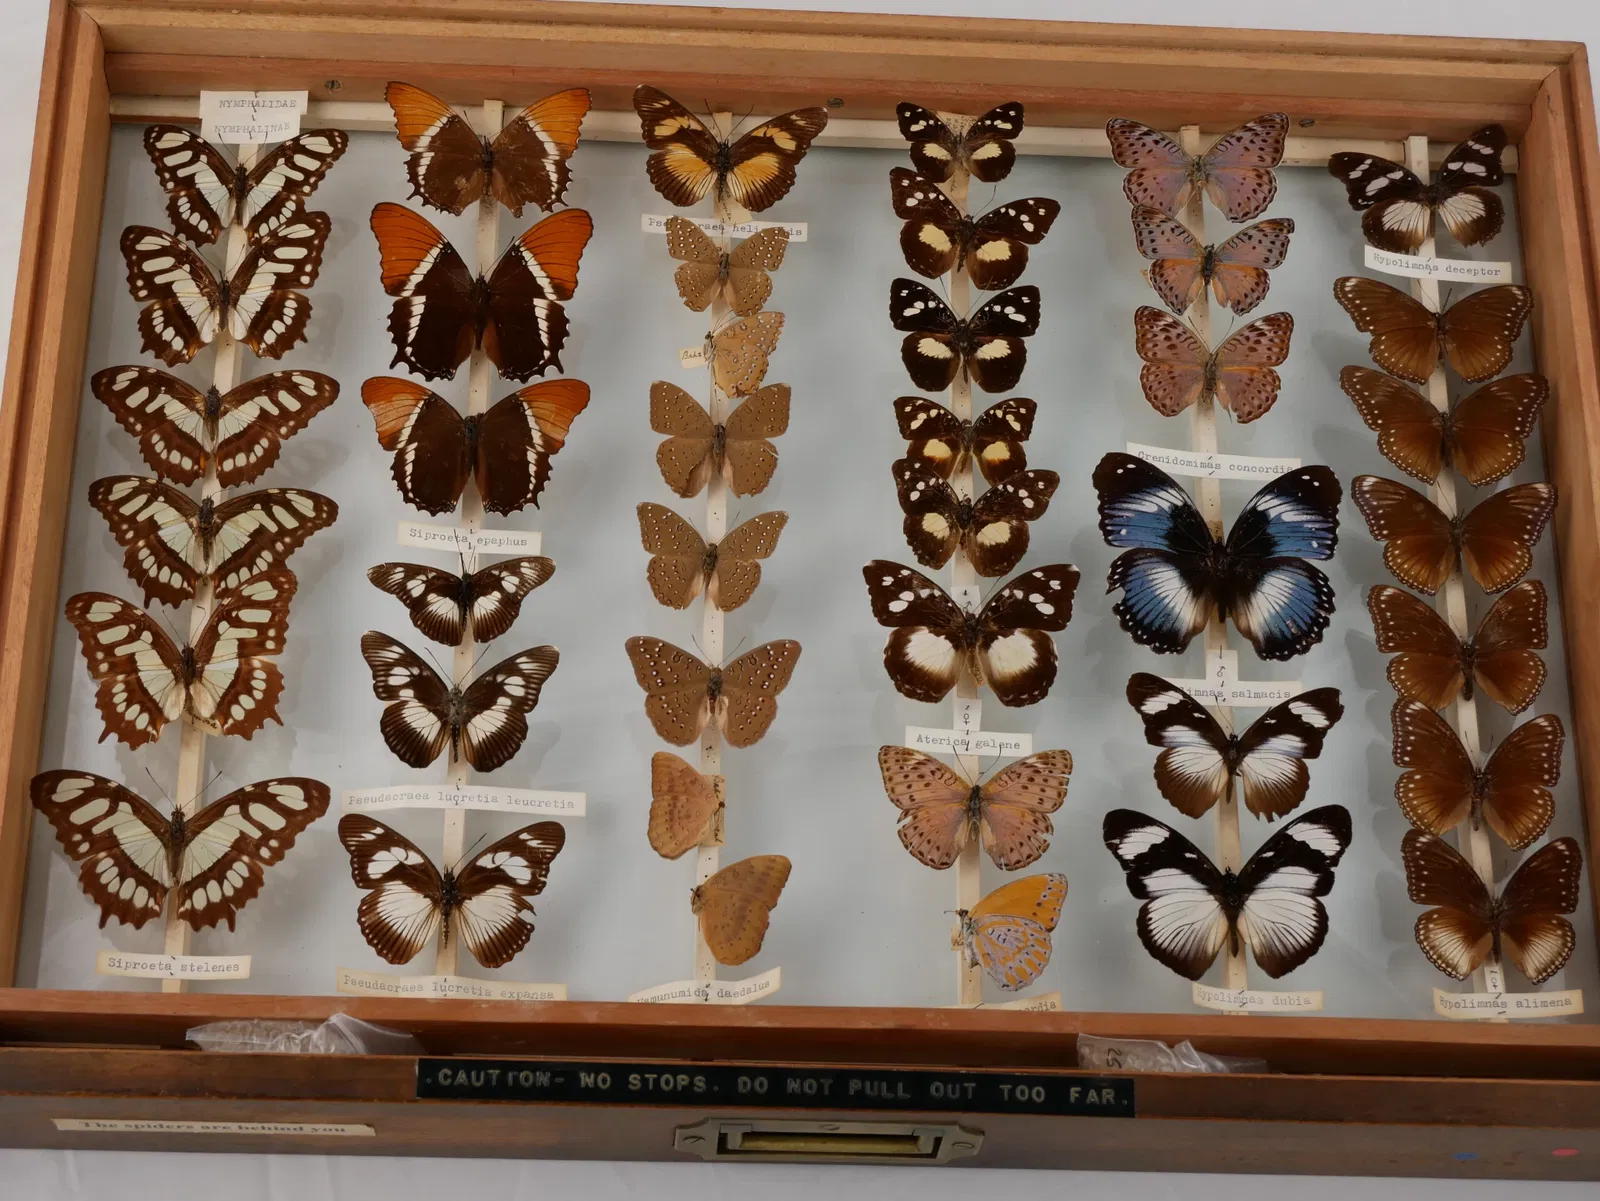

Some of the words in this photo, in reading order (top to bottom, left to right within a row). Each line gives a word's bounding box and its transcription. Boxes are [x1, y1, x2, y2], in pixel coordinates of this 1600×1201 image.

[219, 99, 297, 109] NYMPHALIDAE
[1373, 252, 1439, 271] Hypolimnas
[1445, 264, 1502, 277] deceptor
[1137, 450, 1221, 470] Crenidomimas
[409, 528, 469, 543] Siproeta
[476, 536, 528, 548] epaphus
[1231, 689, 1291, 699] salmacis
[916, 733, 968, 747] Aterica
[975, 738, 1021, 750] galene
[348, 792, 430, 805] Pseudacraea
[437, 791, 499, 804] lucretia
[506, 795, 576, 809] leucretia
[107, 957, 172, 971] Siproeta
[180, 962, 240, 972] stelenes
[343, 974, 424, 992] Pseudacraea
[432, 981, 492, 997] lucretia
[500, 988, 554, 1000] expansa
[716, 979, 770, 998] daedalus
[1272, 995, 1312, 1006] dubia
[1515, 997, 1573, 1009] alimena
[580, 1071, 612, 1091] NO
[737, 1075, 769, 1095] DO
[786, 1077, 834, 1096] NOT
[848, 1078, 912, 1099] PULL
[929, 1082, 977, 1100] OUT
[999, 1084, 1046, 1103] TOO
[79, 1121, 118, 1129] The
